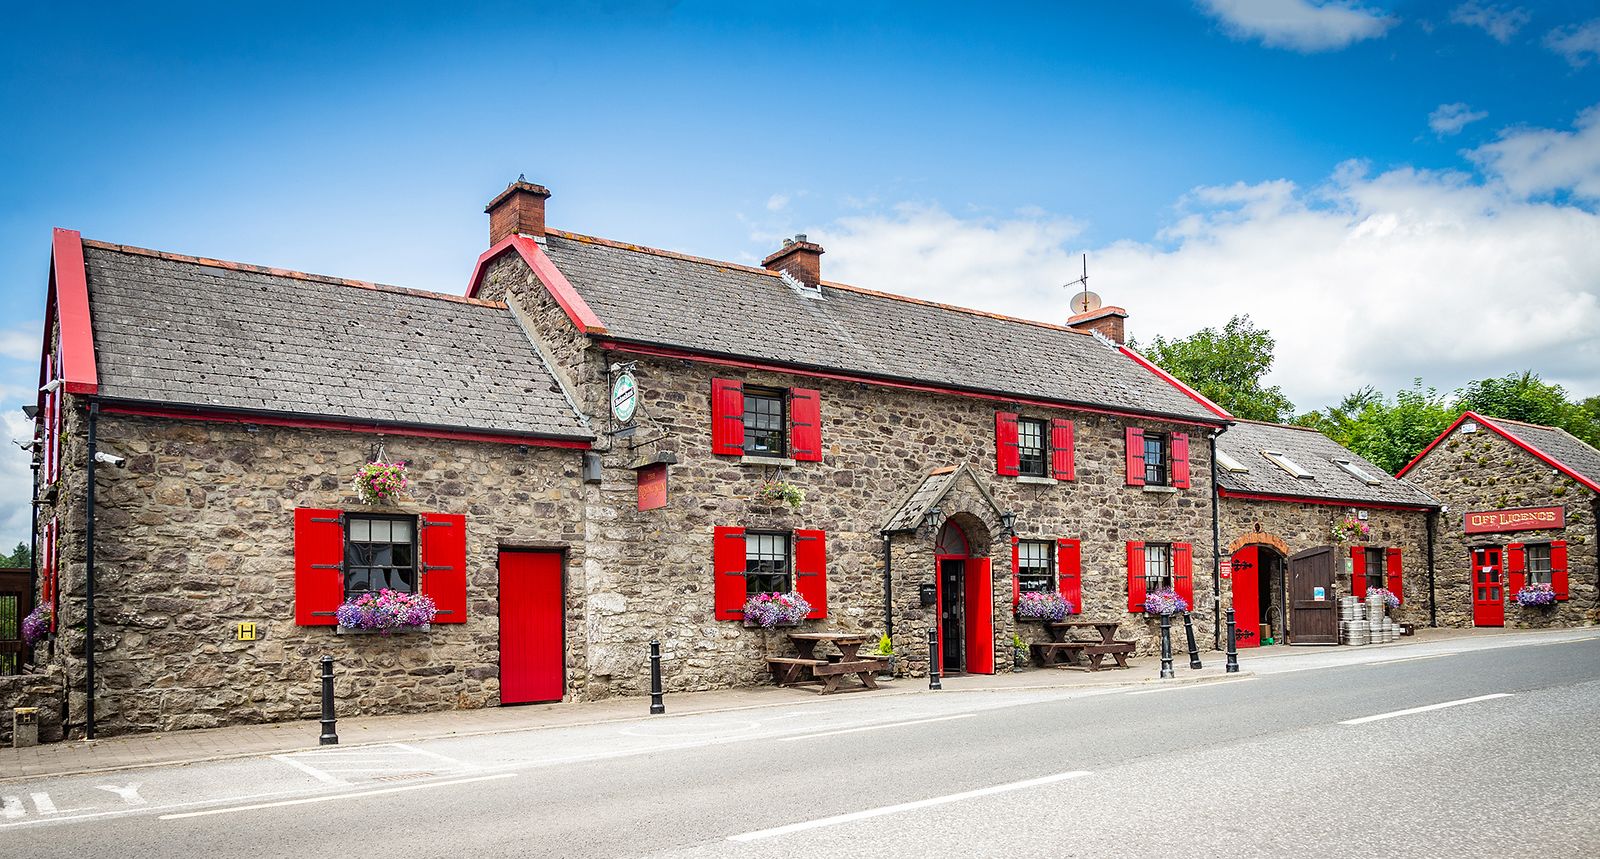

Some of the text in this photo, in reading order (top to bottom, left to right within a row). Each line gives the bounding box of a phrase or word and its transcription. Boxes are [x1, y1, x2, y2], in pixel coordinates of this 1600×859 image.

[1472, 511, 1556, 526] OFF LICENCE
[241, 624, 254, 638] H
